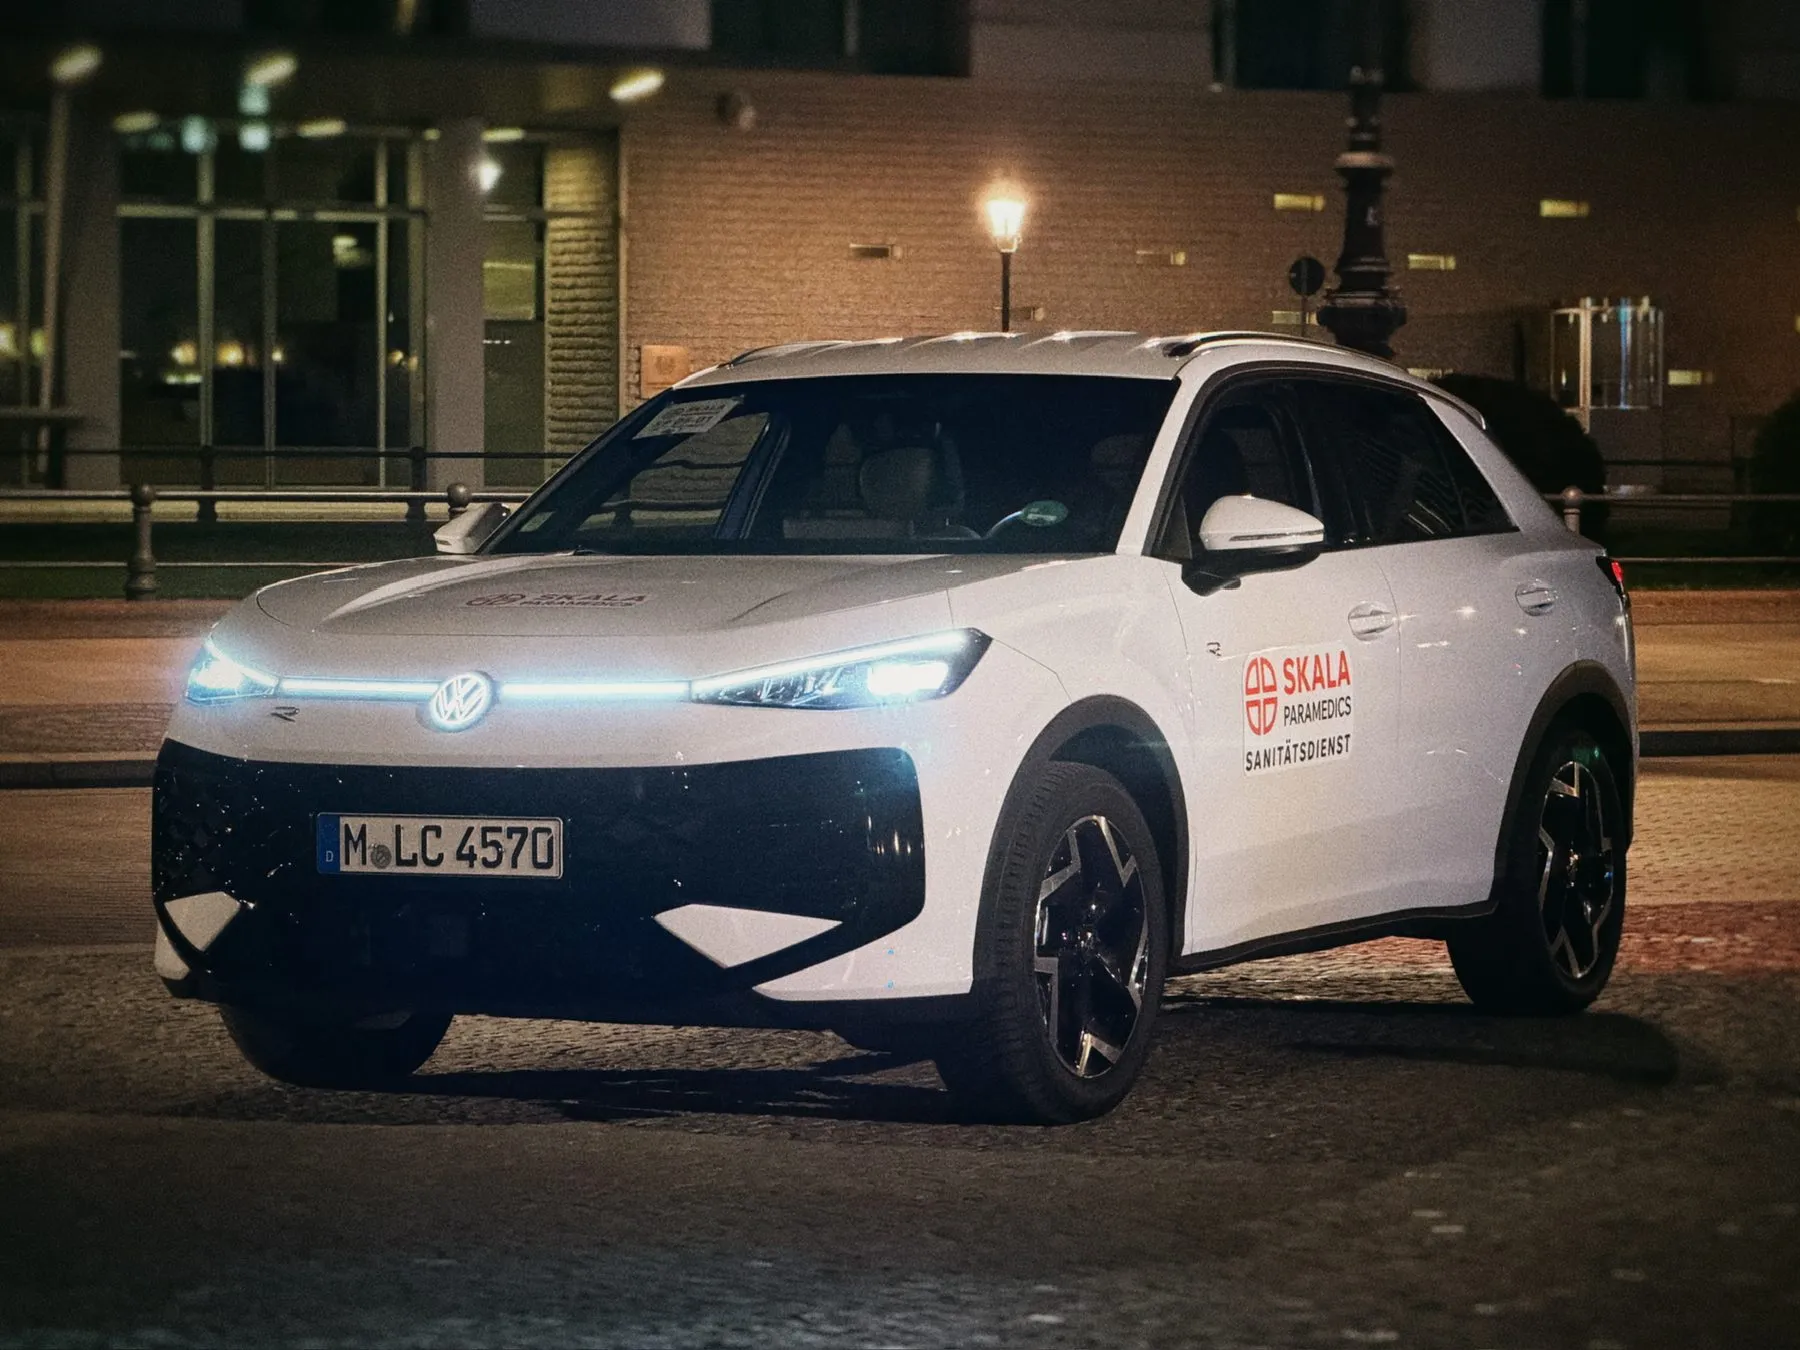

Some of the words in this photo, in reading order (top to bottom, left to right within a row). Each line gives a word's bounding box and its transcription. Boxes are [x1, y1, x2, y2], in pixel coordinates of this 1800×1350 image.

[1283, 650, 1351, 695] SKALA
[1284, 696, 1352, 727] PARAMEDICS
[1245, 733, 1351, 772] SANITÄTSDIENST
[325, 850, 334, 863] D
[344, 823, 367, 866] M
[395, 824, 444, 867] LC
[456, 826, 554, 869] 4570
